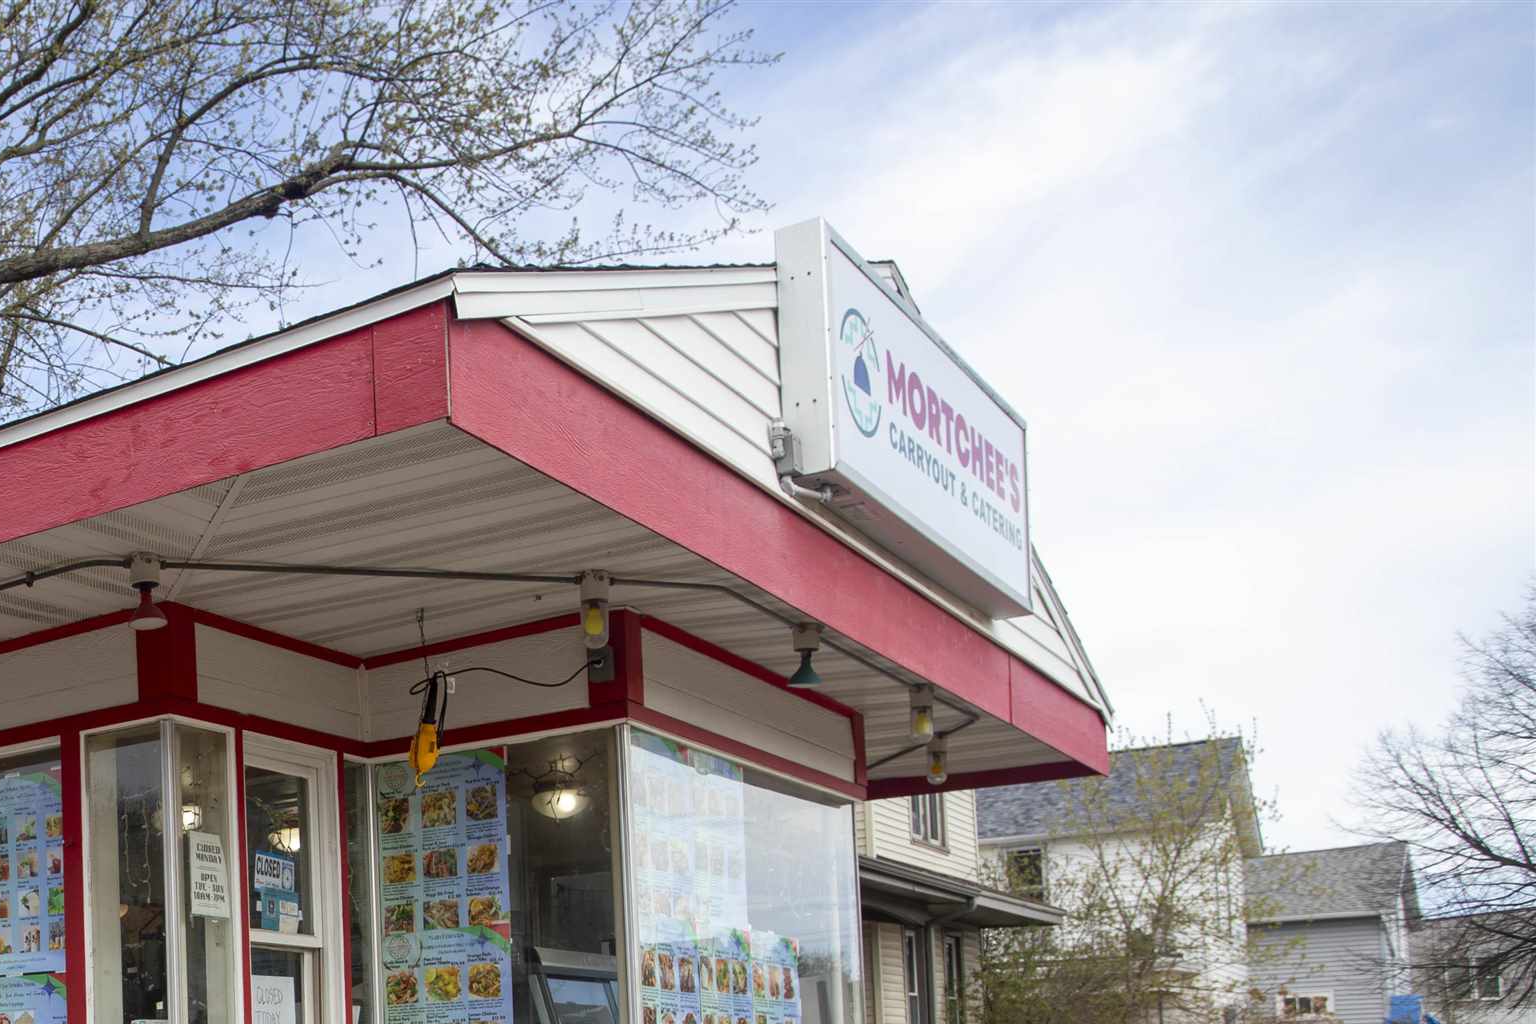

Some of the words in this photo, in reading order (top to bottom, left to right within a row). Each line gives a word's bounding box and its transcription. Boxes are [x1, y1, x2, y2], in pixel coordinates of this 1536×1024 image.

[886, 349, 1020, 513] MORTCHEE'S
[889, 421, 956, 496] CARRYOUT
[960, 482, 968, 506] &
[972, 491, 1022, 550] CATERING
[195, 852, 223, 864] MONDAY
[196, 842, 221, 855] CLOSED
[256, 855, 281, 878] CLOSED
[256, 985, 283, 1005] CLOSED
